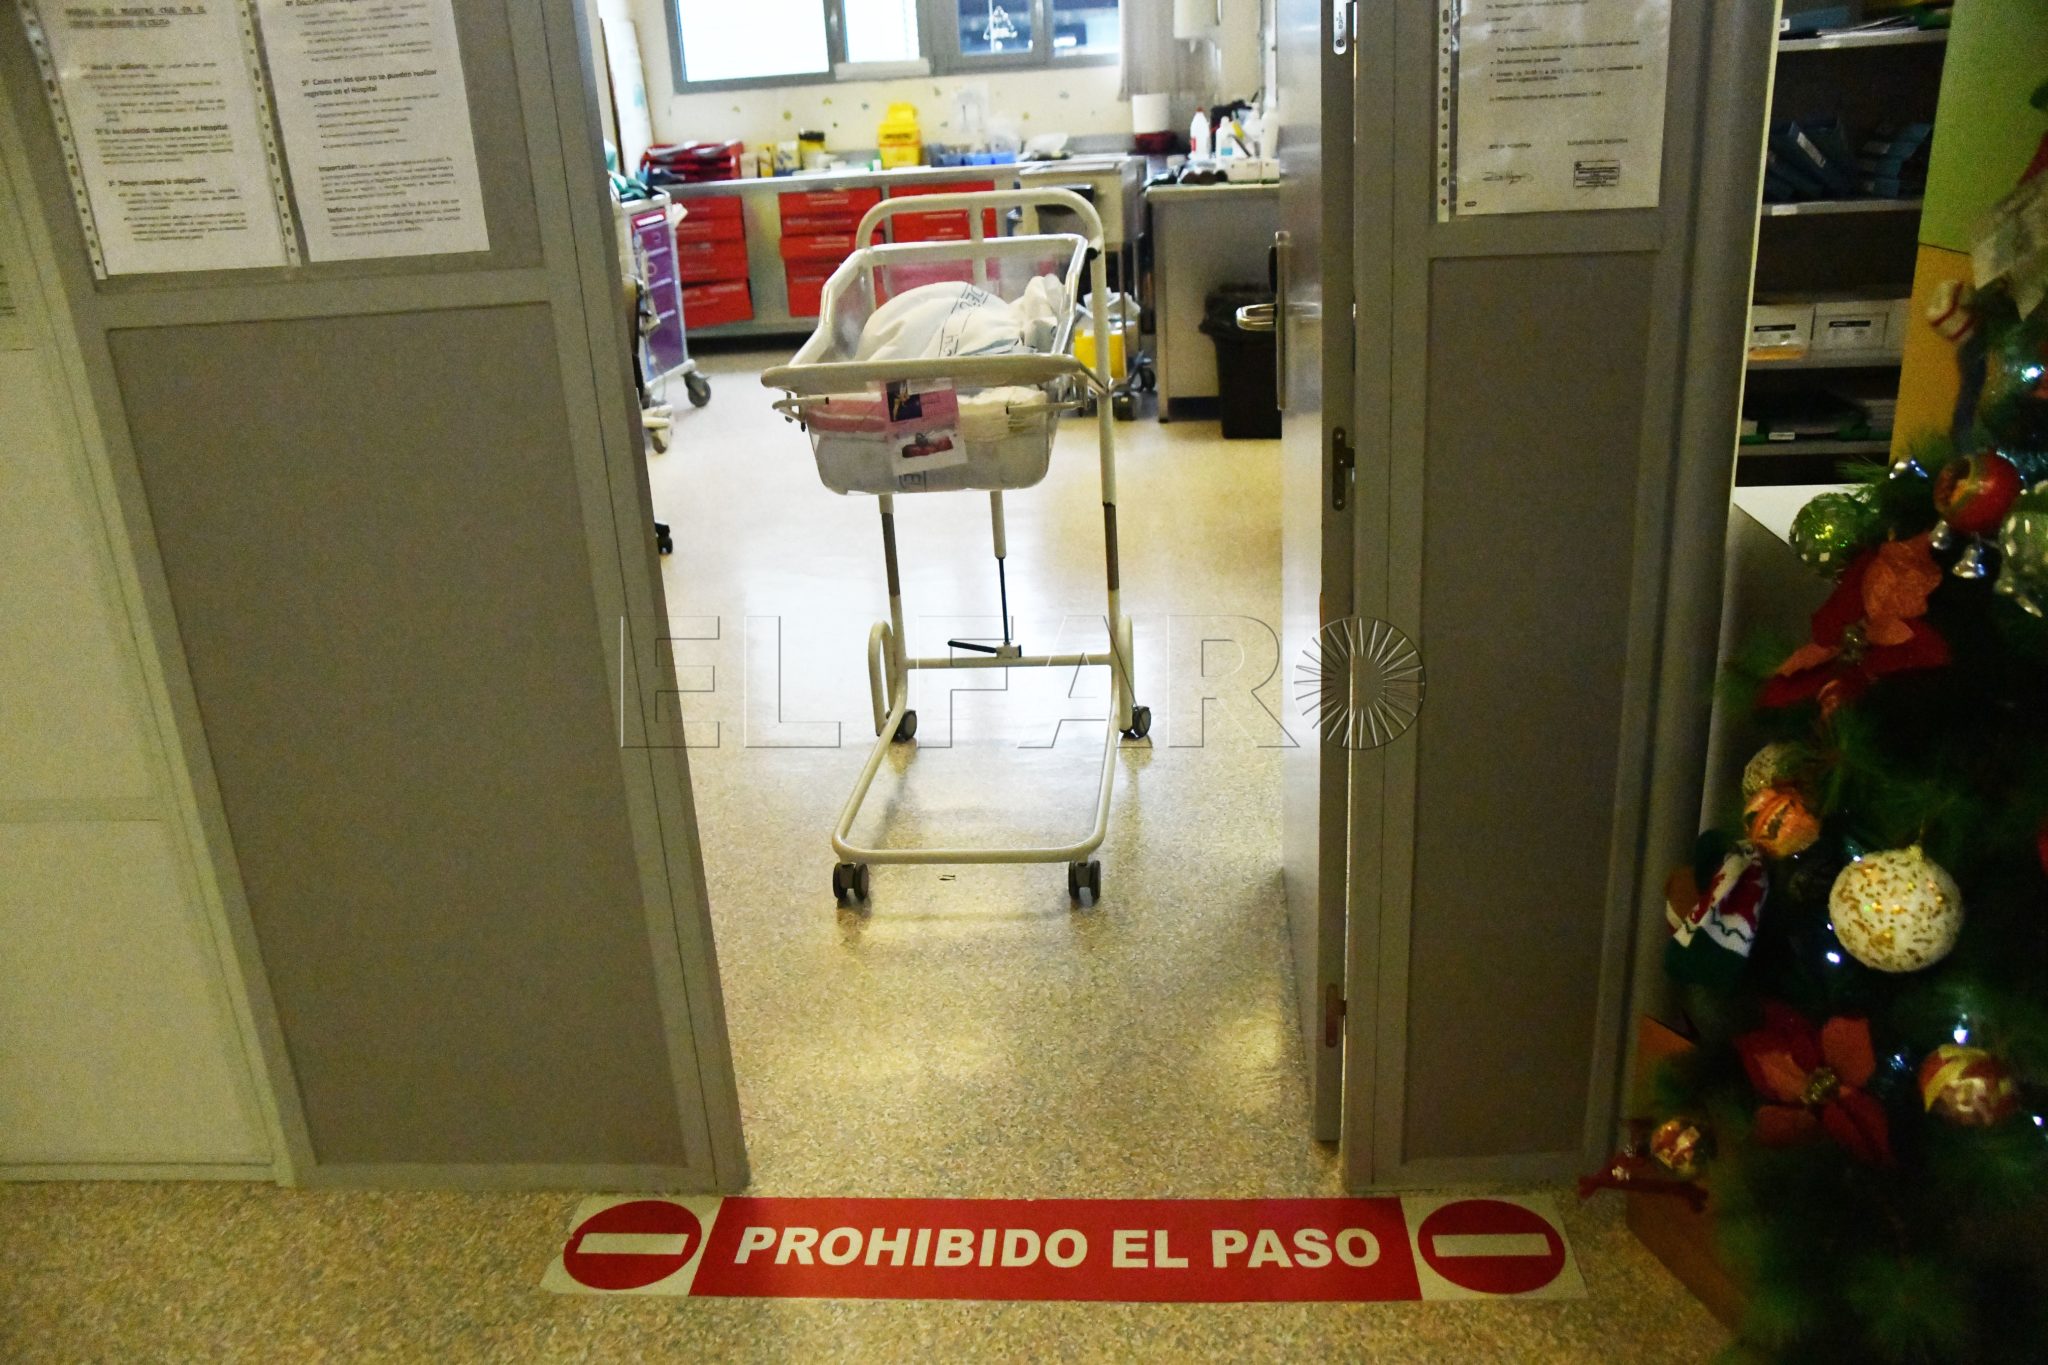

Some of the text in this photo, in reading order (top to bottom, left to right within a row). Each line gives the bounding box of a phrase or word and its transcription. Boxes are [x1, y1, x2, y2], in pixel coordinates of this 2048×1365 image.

[355, 75, 367, 83] que
[387, 71, 412, 79] pueden
[413, 69, 437, 77] realizar
[351, 85, 377, 93] Hospital
[733, 1226, 1381, 1269] PROHIBIDO EL PASO
